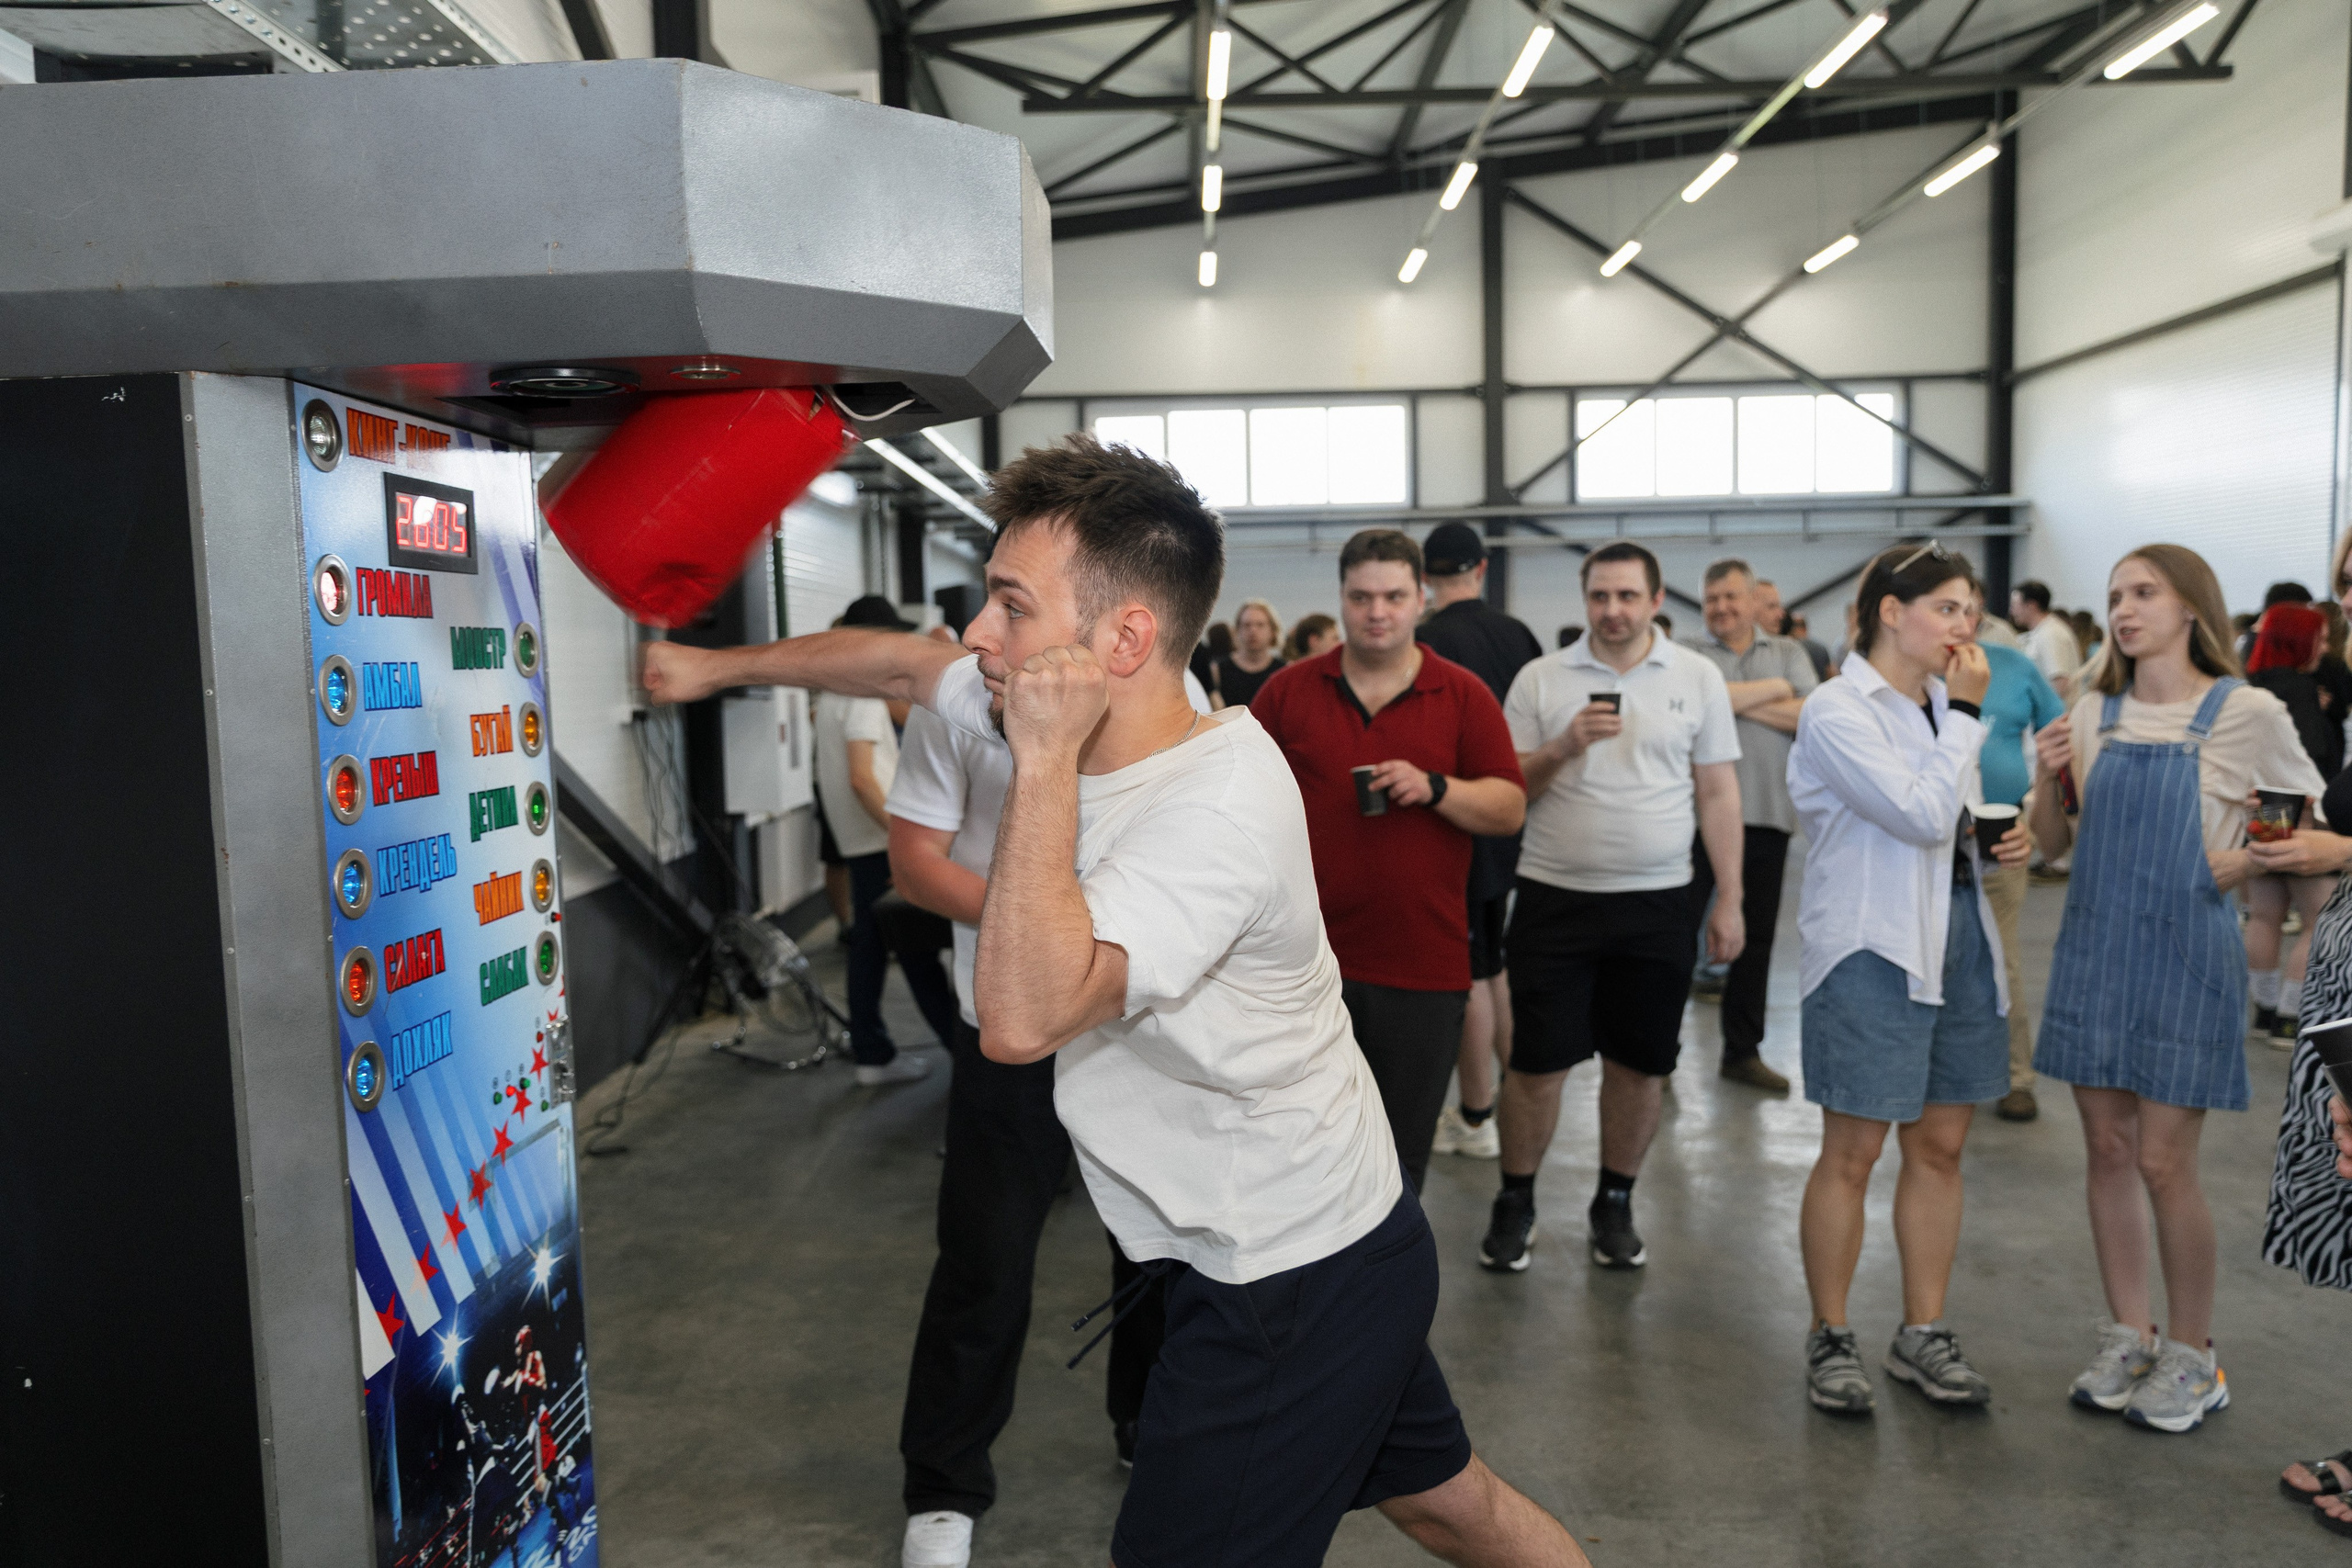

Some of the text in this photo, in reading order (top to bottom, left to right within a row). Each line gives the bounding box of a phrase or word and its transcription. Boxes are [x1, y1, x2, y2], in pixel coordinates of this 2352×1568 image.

[356, 567, 434, 619] ГРОМИЛА
[450, 626, 507, 671] МОНСТР
[363, 661, 423, 711] АМБАЛ
[469, 705, 514, 758] БУГАЙ
[369, 750, 439, 807] КРЕПЫШ
[469, 785, 519, 843] ДЕТИНА
[377, 832, 458, 898] КРЕНДЕЛЬ
[473, 871, 525, 927] ЧАЙНИК
[383, 928, 447, 994] САЛАГА
[479, 945, 529, 1007] СЛАБАК
[391, 1010, 454, 1092] ДОХЛЯК
